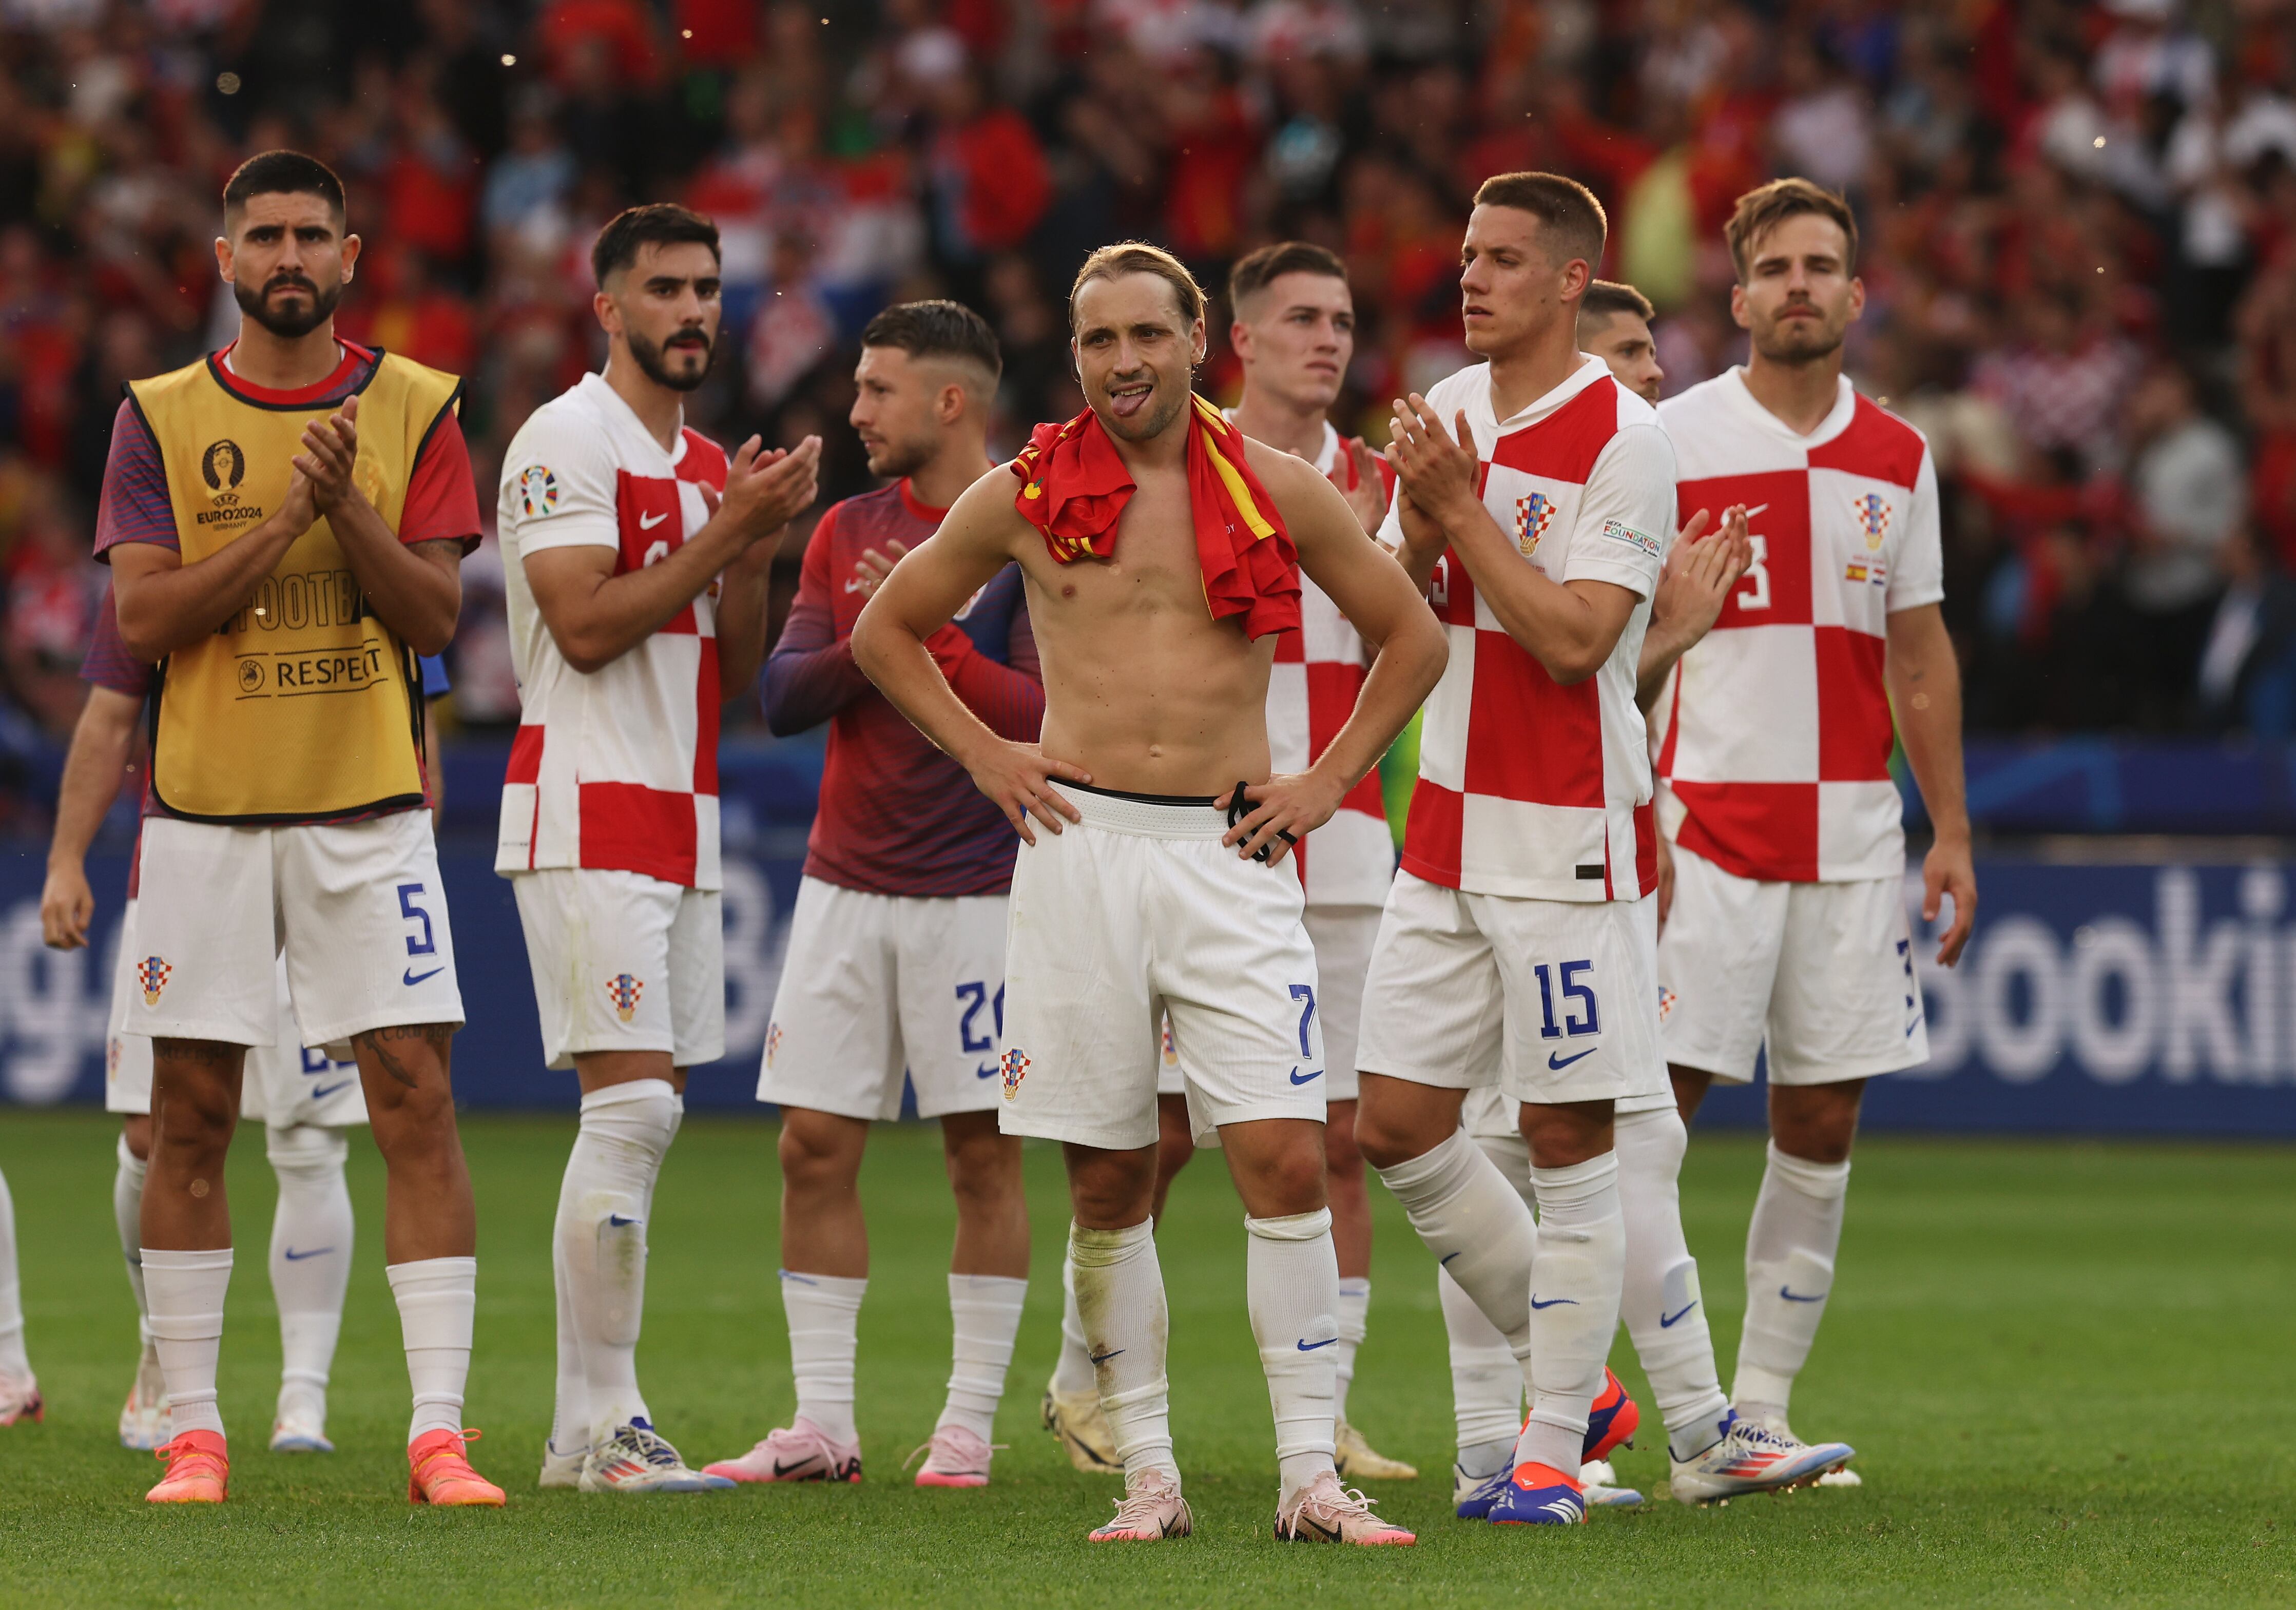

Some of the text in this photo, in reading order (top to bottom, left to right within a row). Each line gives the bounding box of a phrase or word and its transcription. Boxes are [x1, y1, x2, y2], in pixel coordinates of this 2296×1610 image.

[1604, 525, 1661, 553] FOUNDATION
[396, 883, 436, 957] 5
[956, 981, 1004, 1053] 2
[1288, 984, 1316, 1060] 7
[1534, 960, 1601, 1040] 15
